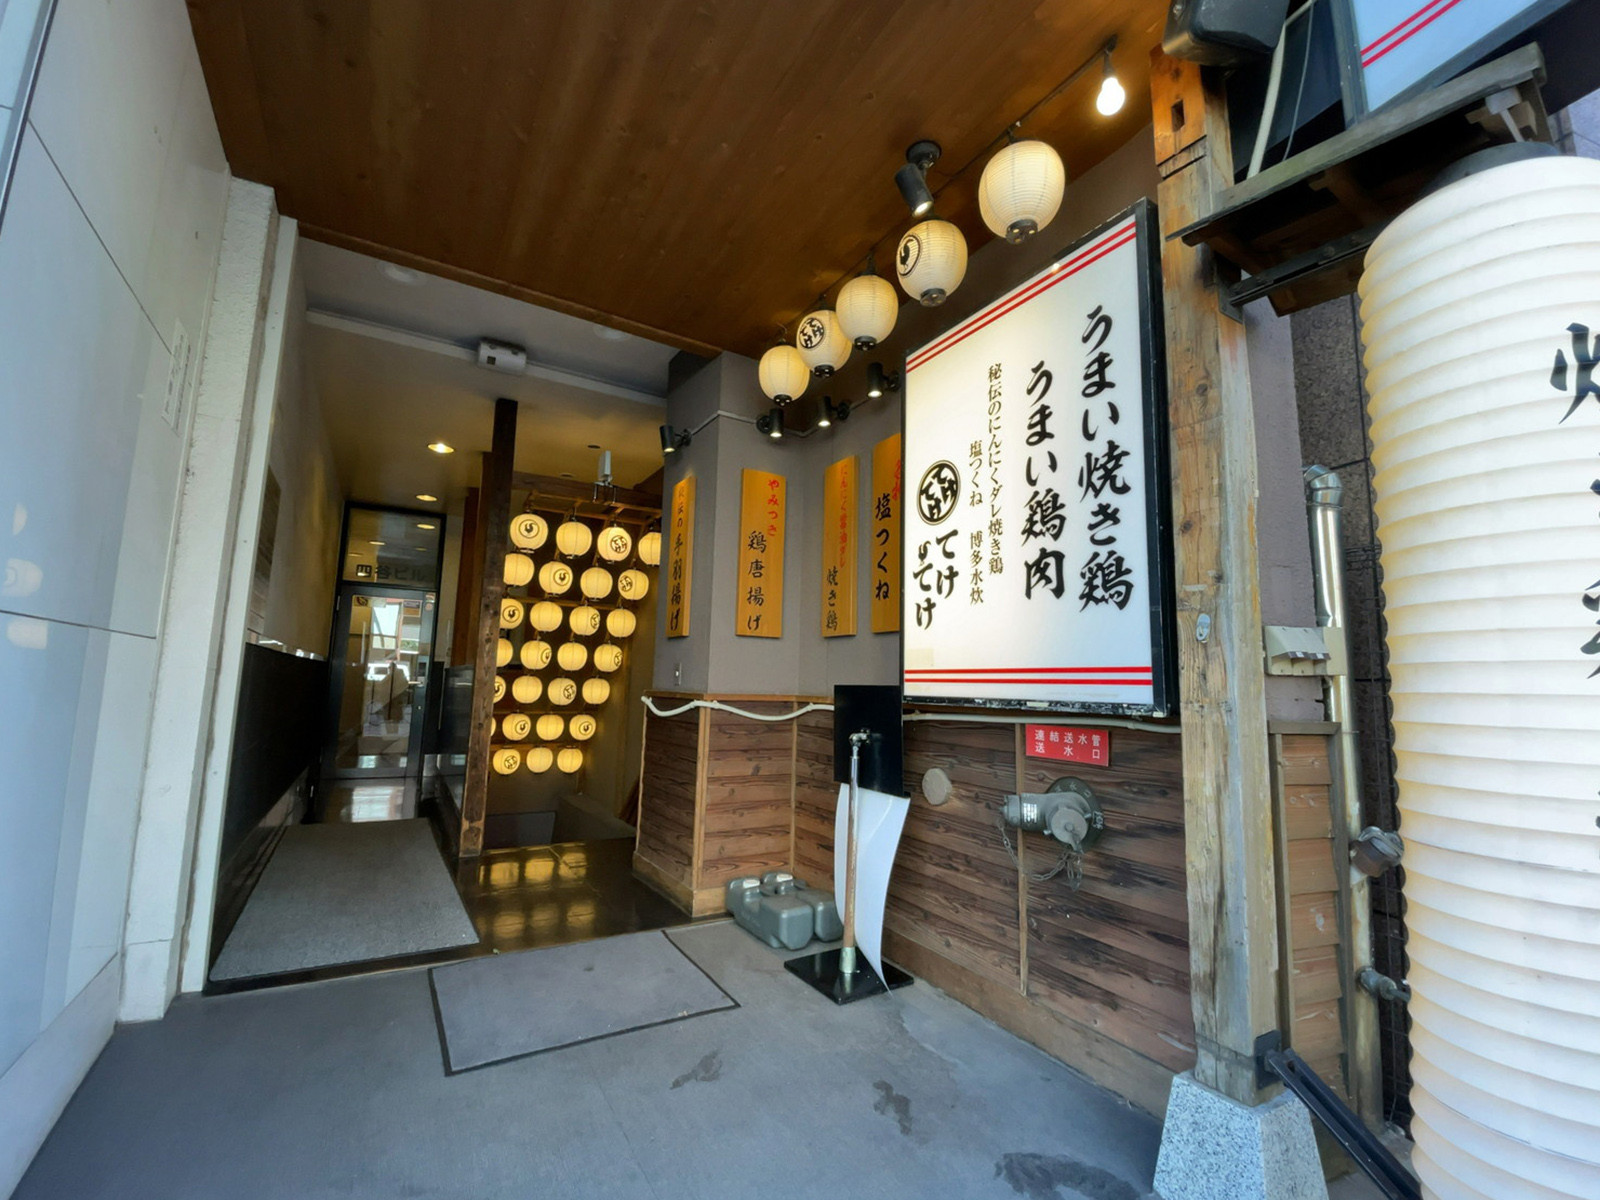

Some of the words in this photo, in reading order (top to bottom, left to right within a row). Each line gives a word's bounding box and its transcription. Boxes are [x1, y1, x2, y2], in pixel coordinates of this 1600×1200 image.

[969, 439, 984, 508] 塩つくね
[987, 362, 1004, 576] 秘伝のにんにくダレ焼き鶏
[1020, 360, 1067, 600] うまい鶏肉
[1078, 304, 1135, 613] うまい焼き鶏
[767, 478, 780, 537] やみつき
[746, 530, 767, 631] 鶏唐揚げ
[875, 492, 892, 601] 塩つくね
[969, 530, 985, 606] 博多水炊
[826, 565, 839, 632] 焼き鶏
[1035, 729, 1101, 747] 連結送水管
[1035, 742, 1101, 760] 送水口
